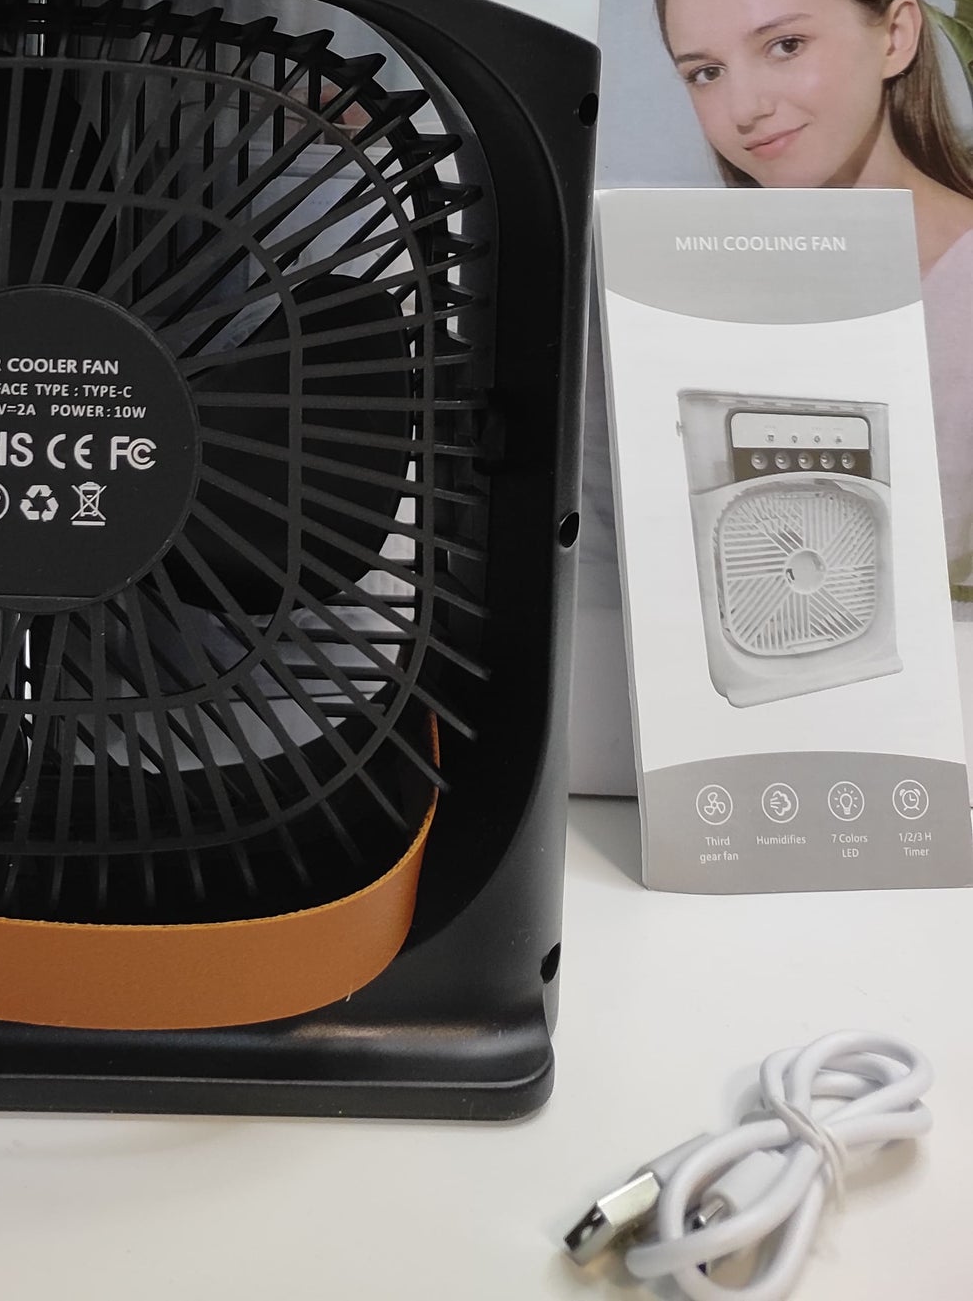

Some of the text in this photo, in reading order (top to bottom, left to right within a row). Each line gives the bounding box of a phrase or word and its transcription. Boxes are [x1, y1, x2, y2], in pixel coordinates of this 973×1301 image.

[675, 236, 847, 251] MINI COOLING FAN
[6, 357, 78, 374] COOLER
[82, 359, 119, 375] FAN
[34, 383, 70, 397] TYPE
[82, 384, 133, 398] TYPE-C
[46, 433, 94, 470] CE
[705, 836, 731, 847] Third
[756, 834, 807, 846] Humidifies
[831, 833, 868, 844] 7 Colors
[699, 852, 739, 864] gear fan
[842, 848, 860, 859] LED
[903, 847, 930, 858] Timer
